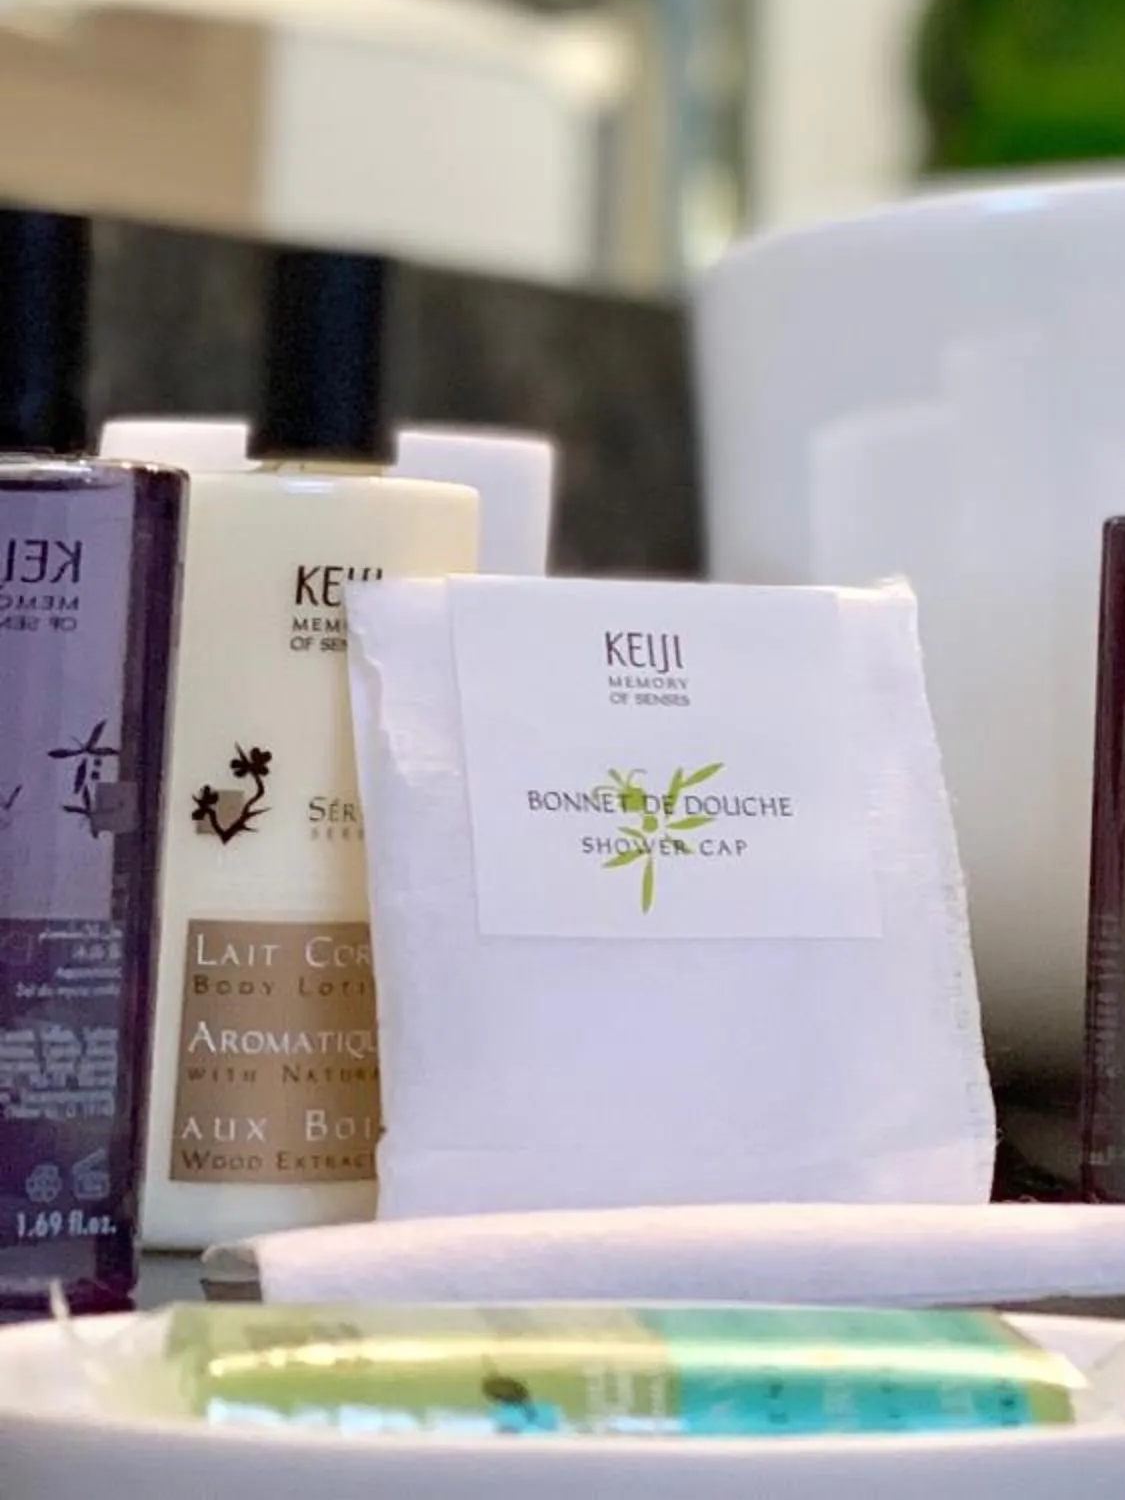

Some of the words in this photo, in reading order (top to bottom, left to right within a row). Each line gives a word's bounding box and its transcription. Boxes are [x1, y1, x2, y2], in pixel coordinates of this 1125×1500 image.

[292, 617, 341, 632] MEM
[605, 631, 685, 674] KEIJI
[608, 675, 688, 690] MEMORY
[609, 691, 629, 705] OF
[308, 795, 358, 822] SÉR
[527, 790, 632, 814] BONNET
[642, 794, 675, 815] DE
[684, 795, 794, 818] DOUCHE
[581, 836, 686, 856] SHOWER
[700, 839, 748, 857] CAP
[196, 933, 280, 967] LAIT
[305, 936, 372, 968] COR
[193, 974, 275, 996] BODY
[299, 976, 367, 997] LOTI
[181, 1116, 268, 1142] AUX
[305, 1109, 372, 1142] BOI
[182, 1150, 264, 1172] WOOD
[17, 1211, 62, 1237] 1.69
